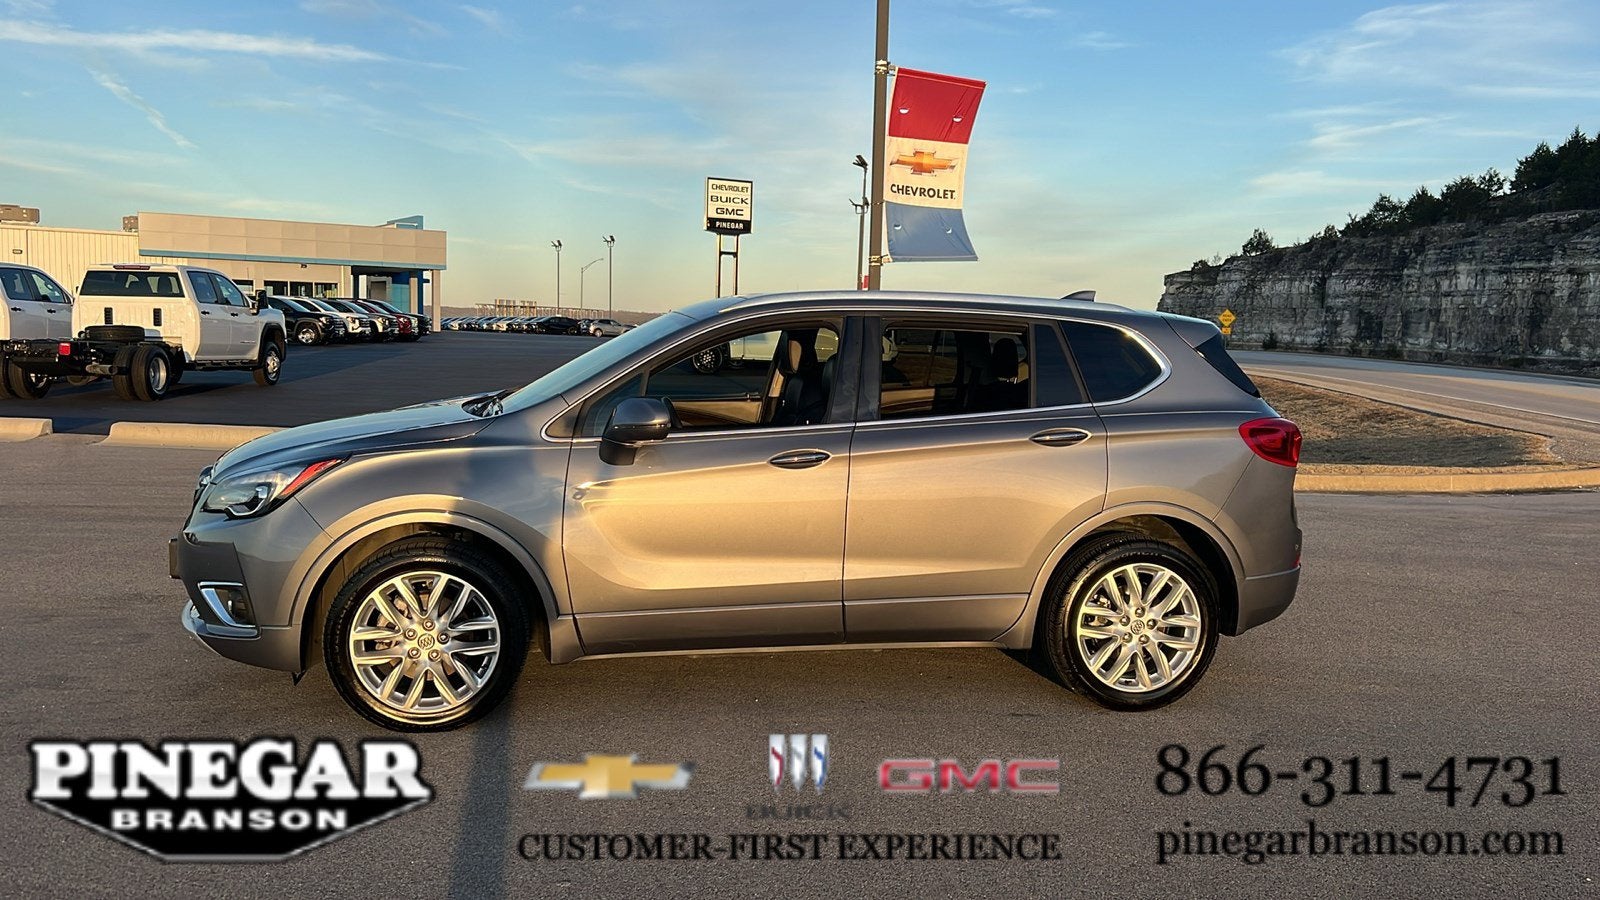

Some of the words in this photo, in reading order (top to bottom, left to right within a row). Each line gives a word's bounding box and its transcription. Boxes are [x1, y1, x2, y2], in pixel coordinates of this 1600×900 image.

[711, 183, 749, 193] CHEVROLET
[890, 183, 955, 200] CHEVROLET
[710, 195, 749, 205] BUICK
[715, 207, 744, 216] GMC
[715, 221, 744, 229] PINEGAR
